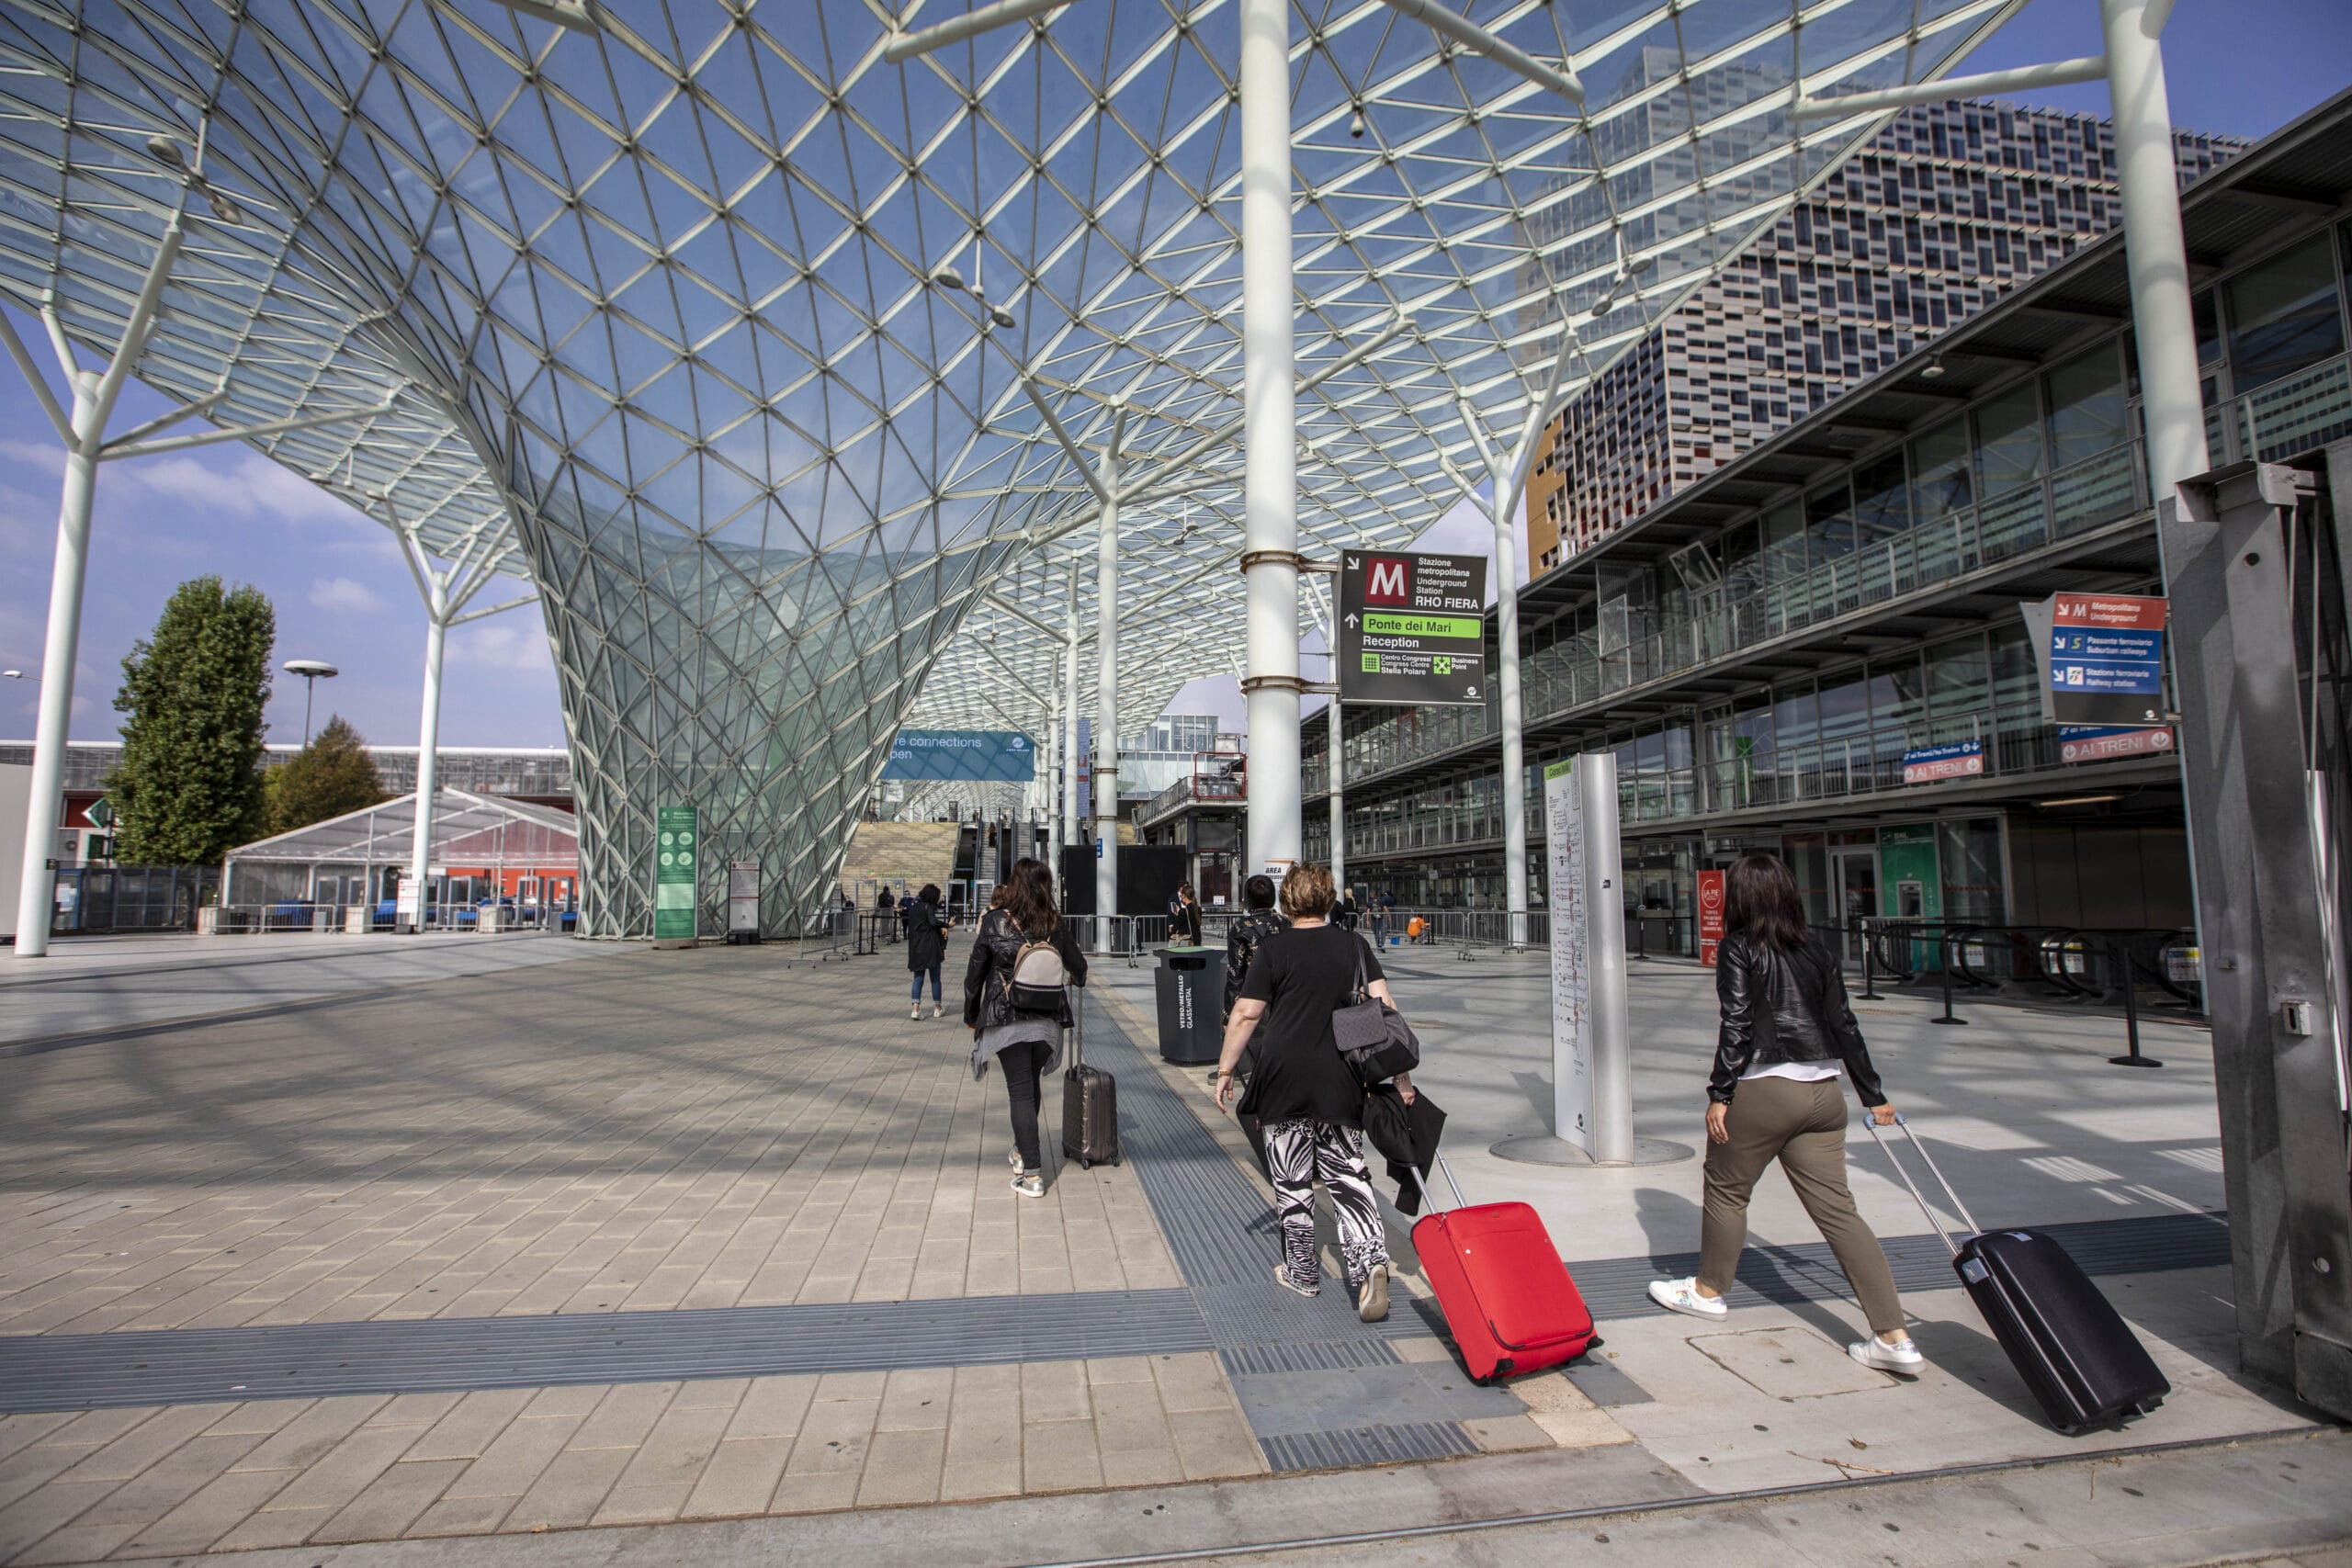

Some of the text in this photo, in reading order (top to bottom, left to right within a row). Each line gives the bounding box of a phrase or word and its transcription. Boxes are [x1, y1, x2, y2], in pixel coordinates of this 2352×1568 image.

[1419, 558, 1452, 567] Stazione
[1418, 568, 1470, 577] metropolitana
[1370, 563, 1405, 596] M
[1417, 578, 1466, 588] Underground
[1416, 587, 1443, 595] Station
[1416, 596, 1478, 609] RHO FIERA
[2091, 603, 2141, 612] Metropolitana
[2073, 604, 2086, 617] M
[2090, 613, 2138, 623] Underground
[1368, 618, 1451, 633] Ponte dei Mari
[1363, 636, 1419, 649] Reception
[2087, 637, 2154, 646] Passante ferroviario
[2086, 646, 2147, 657] Suburban railways
[895, 737, 981, 747] re connections
[2080, 737, 2143, 756] AI TRENI
[890, 750, 911, 761] pen
[1917, 762, 1962, 777] AI TRENI
